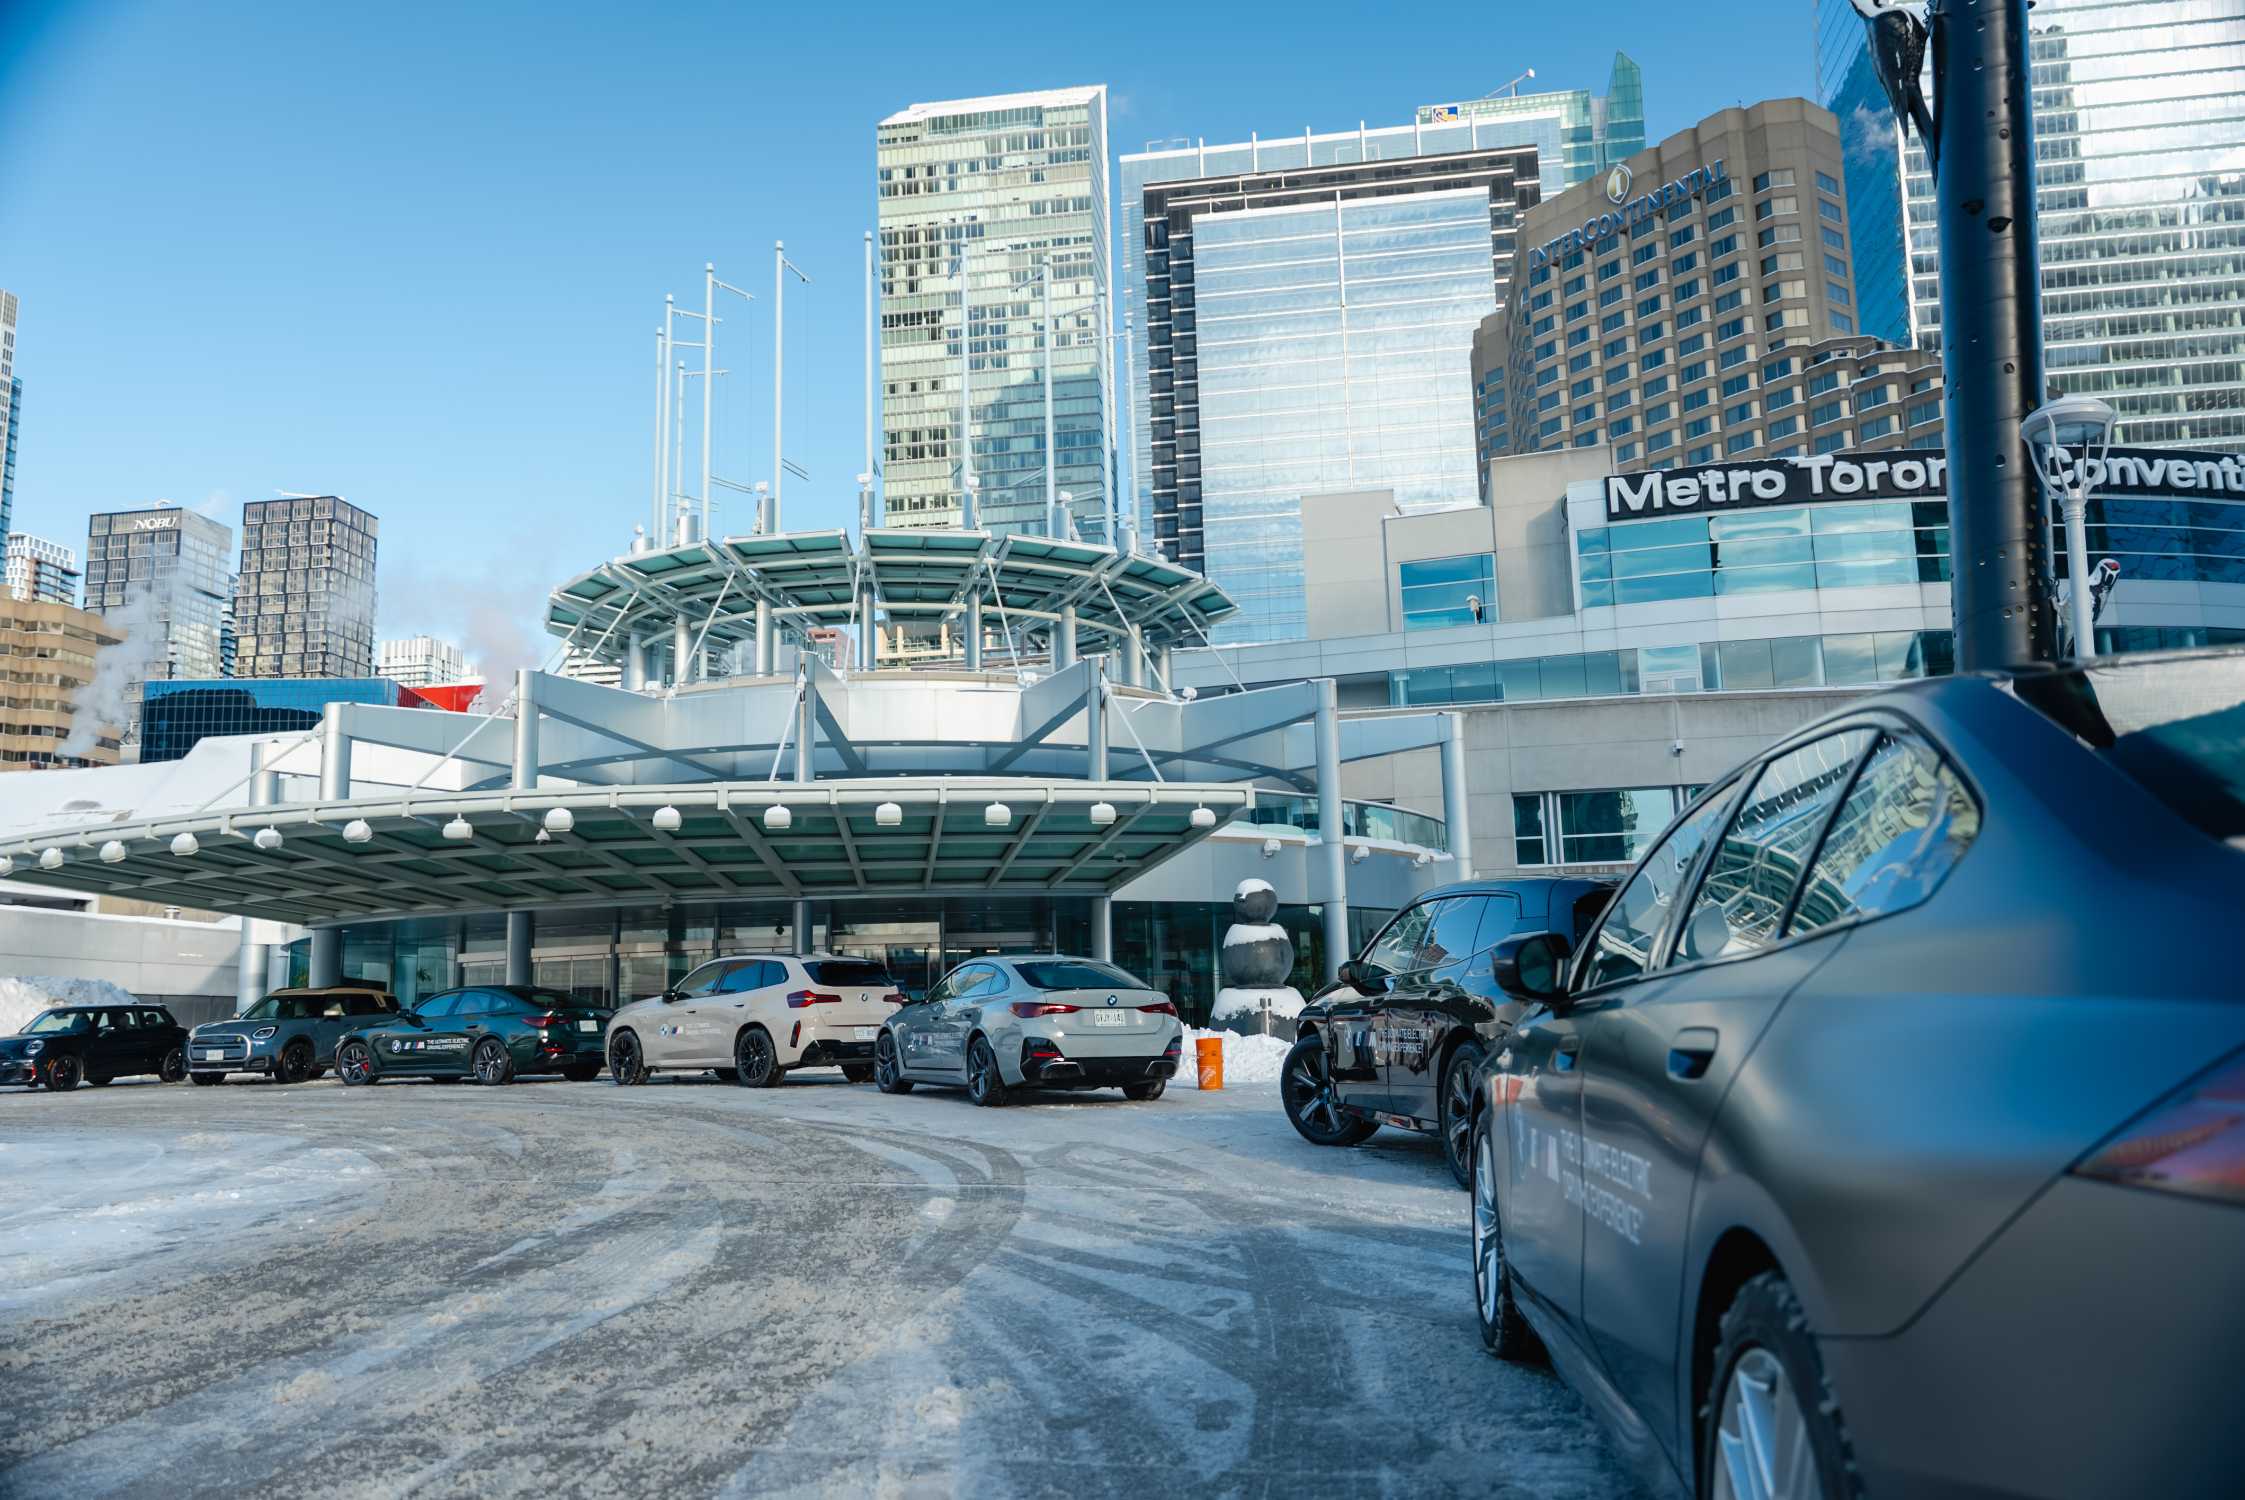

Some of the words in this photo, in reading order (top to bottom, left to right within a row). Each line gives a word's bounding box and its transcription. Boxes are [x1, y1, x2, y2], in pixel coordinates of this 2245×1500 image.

[1528, 159, 1728, 268] INTERCONTINENTAL
[1608, 468, 1787, 514] Metro
[134, 517, 177, 529] NOBU
